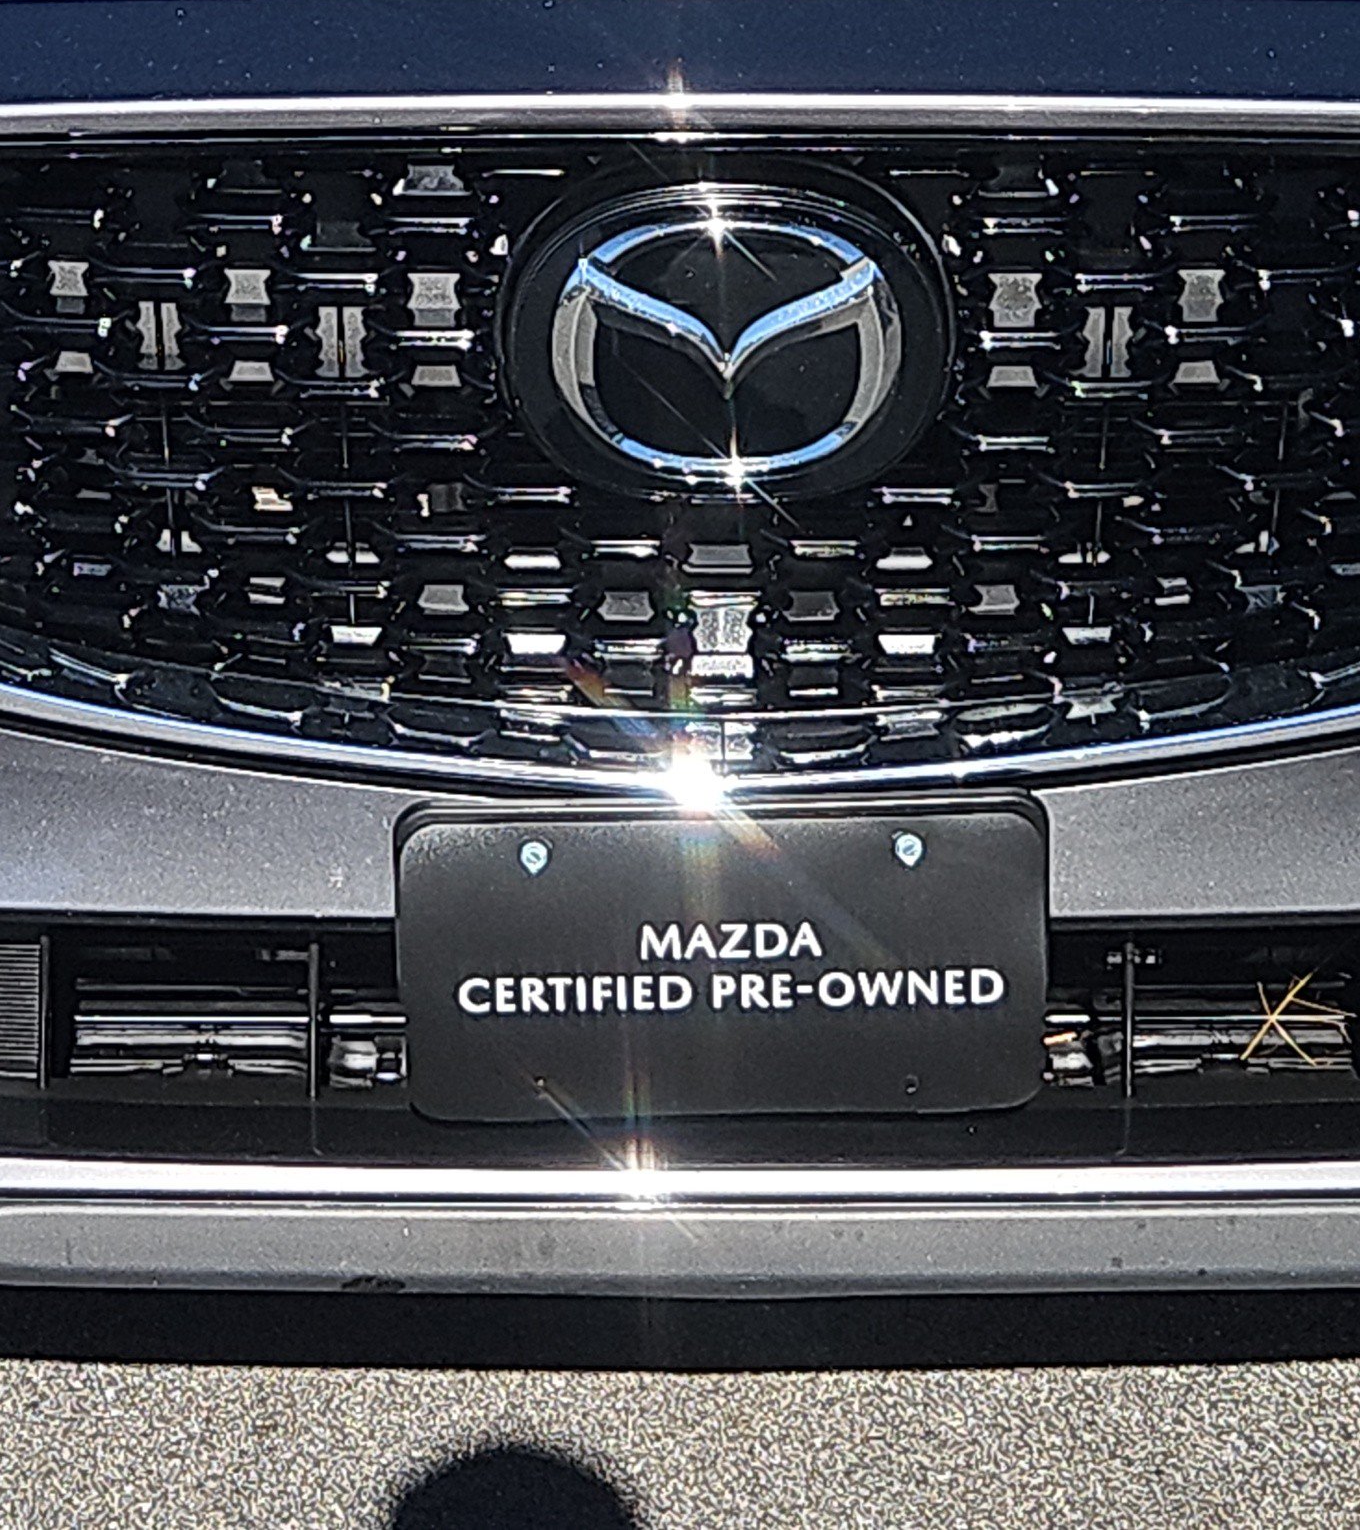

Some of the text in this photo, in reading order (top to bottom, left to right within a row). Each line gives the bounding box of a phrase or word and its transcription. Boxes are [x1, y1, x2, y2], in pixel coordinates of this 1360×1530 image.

[640, 922, 823, 960] MAZDA
[459, 968, 1005, 1013] CERTIFIED PRE-OWNED
